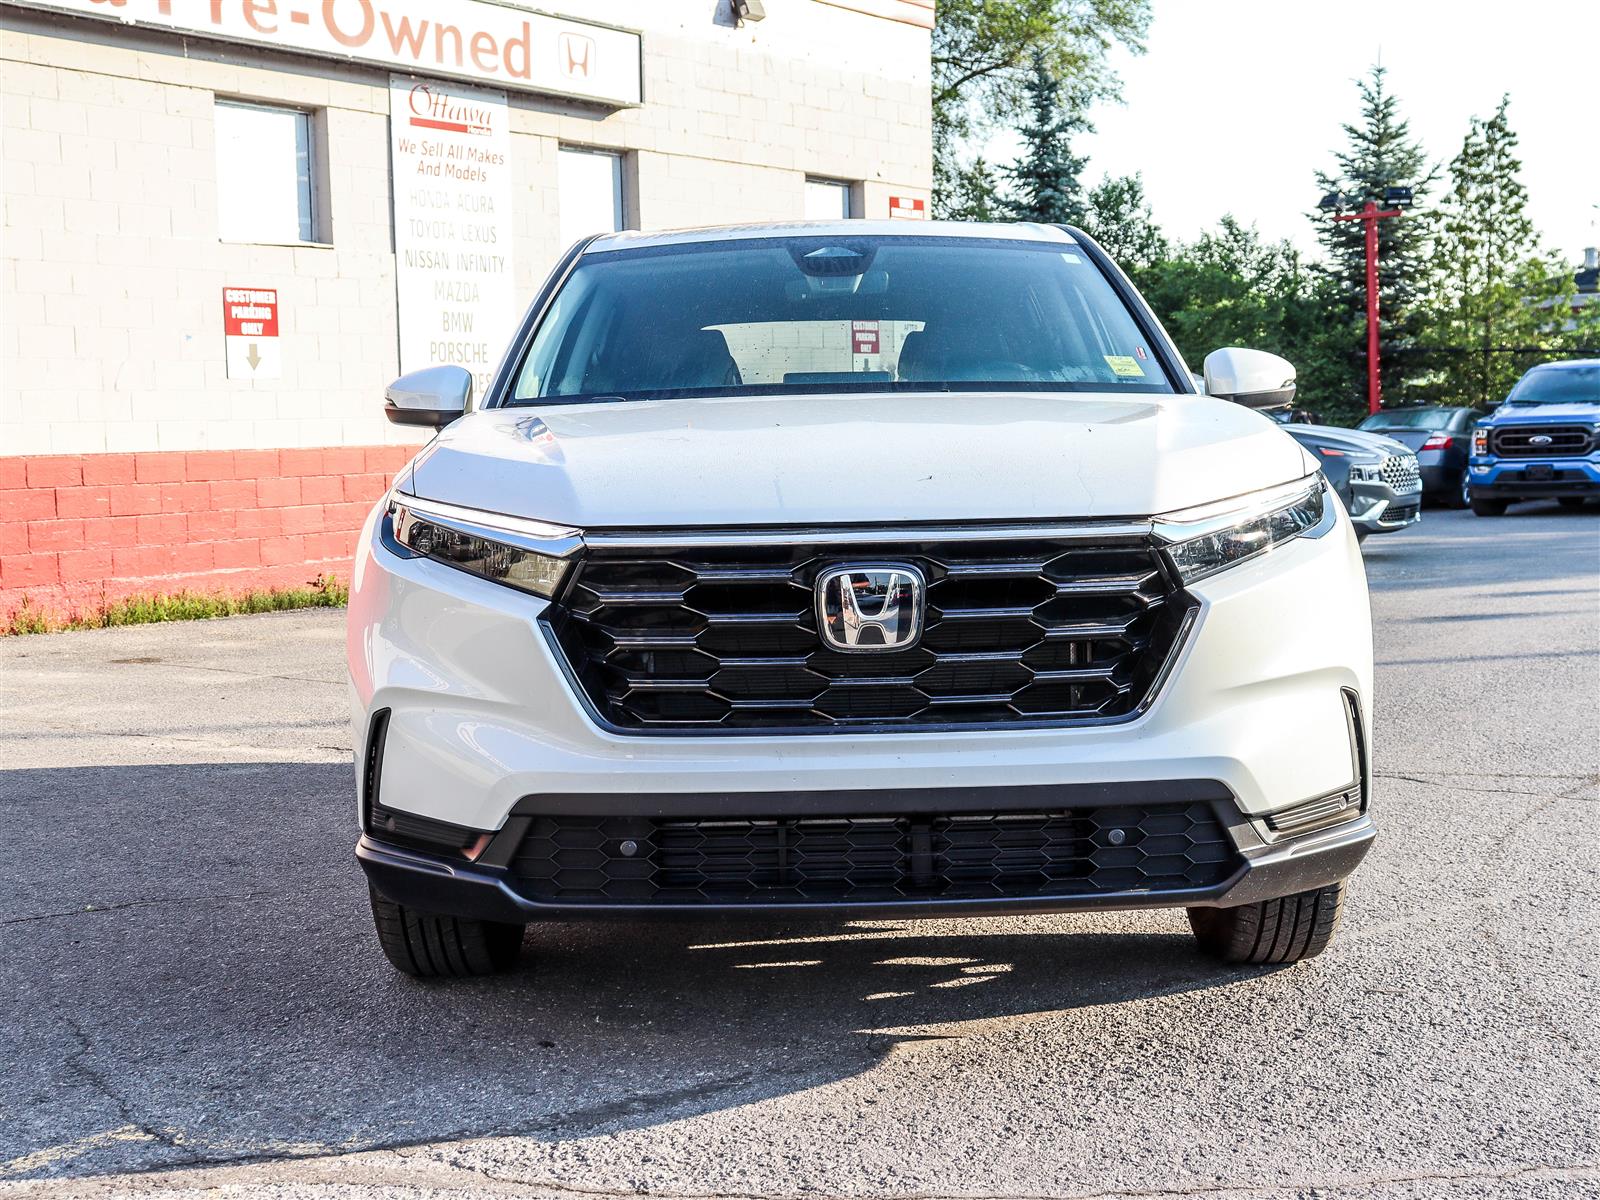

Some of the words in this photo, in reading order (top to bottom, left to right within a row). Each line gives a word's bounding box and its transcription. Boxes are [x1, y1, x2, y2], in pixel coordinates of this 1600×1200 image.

[158, 0, 533, 79] re-Owned
[409, 83, 491, 125] Ottawa
[399, 138, 416, 154] We
[421, 140, 443, 157] Sell
[447, 145, 463, 160] All
[467, 147, 504, 165] Makes
[417, 160, 440, 177] And
[445, 163, 487, 182] Models
[410, 188, 450, 208] HONDA
[457, 193, 495, 213] ACURA
[409, 218, 454, 239] TOYOTA
[461, 224, 497, 244] LEXUS
[405, 249, 449, 270] NISSAN
[457, 253, 505, 273] INFINITY
[434, 280, 480, 302] MAZDA
[442, 311, 474, 333] BMW
[430, 341, 488, 364] PORSCHE
